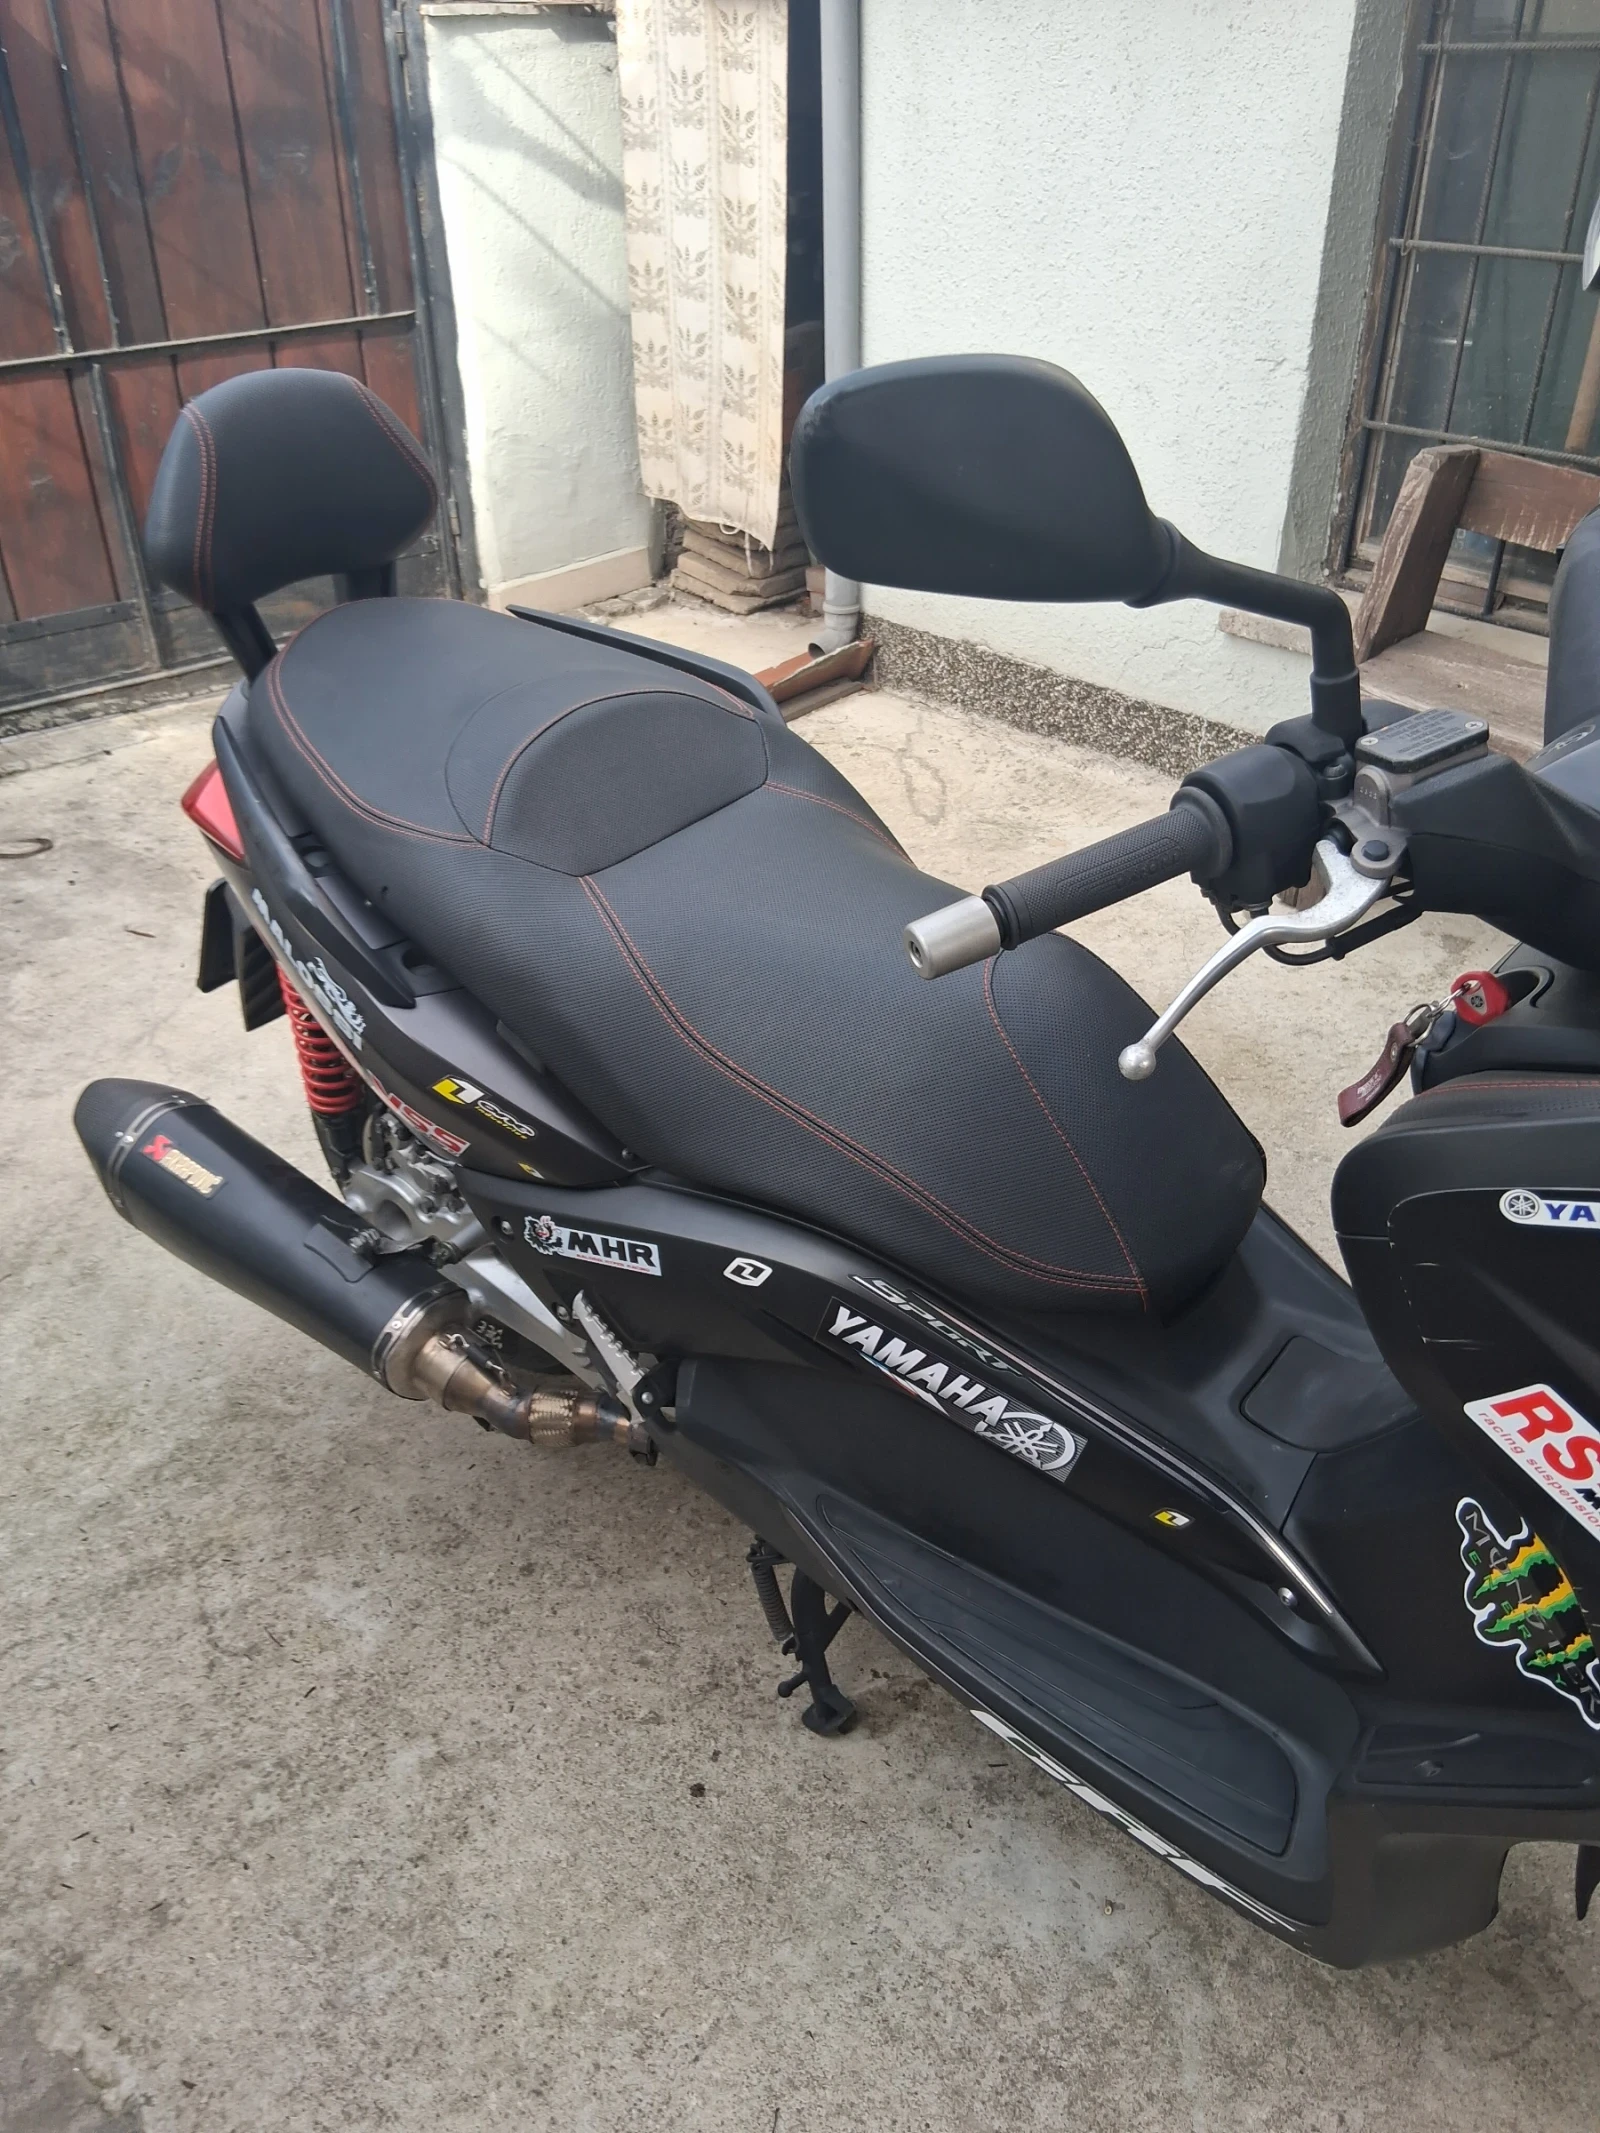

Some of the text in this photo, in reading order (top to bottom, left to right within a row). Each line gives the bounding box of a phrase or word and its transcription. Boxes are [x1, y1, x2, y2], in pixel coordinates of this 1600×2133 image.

[567, 1231, 656, 1268] MHR
[852, 1276, 1023, 1377] SPORT
[828, 1305, 1009, 1427] YAMAHA
[1478, 1412, 1525, 1455] racing
